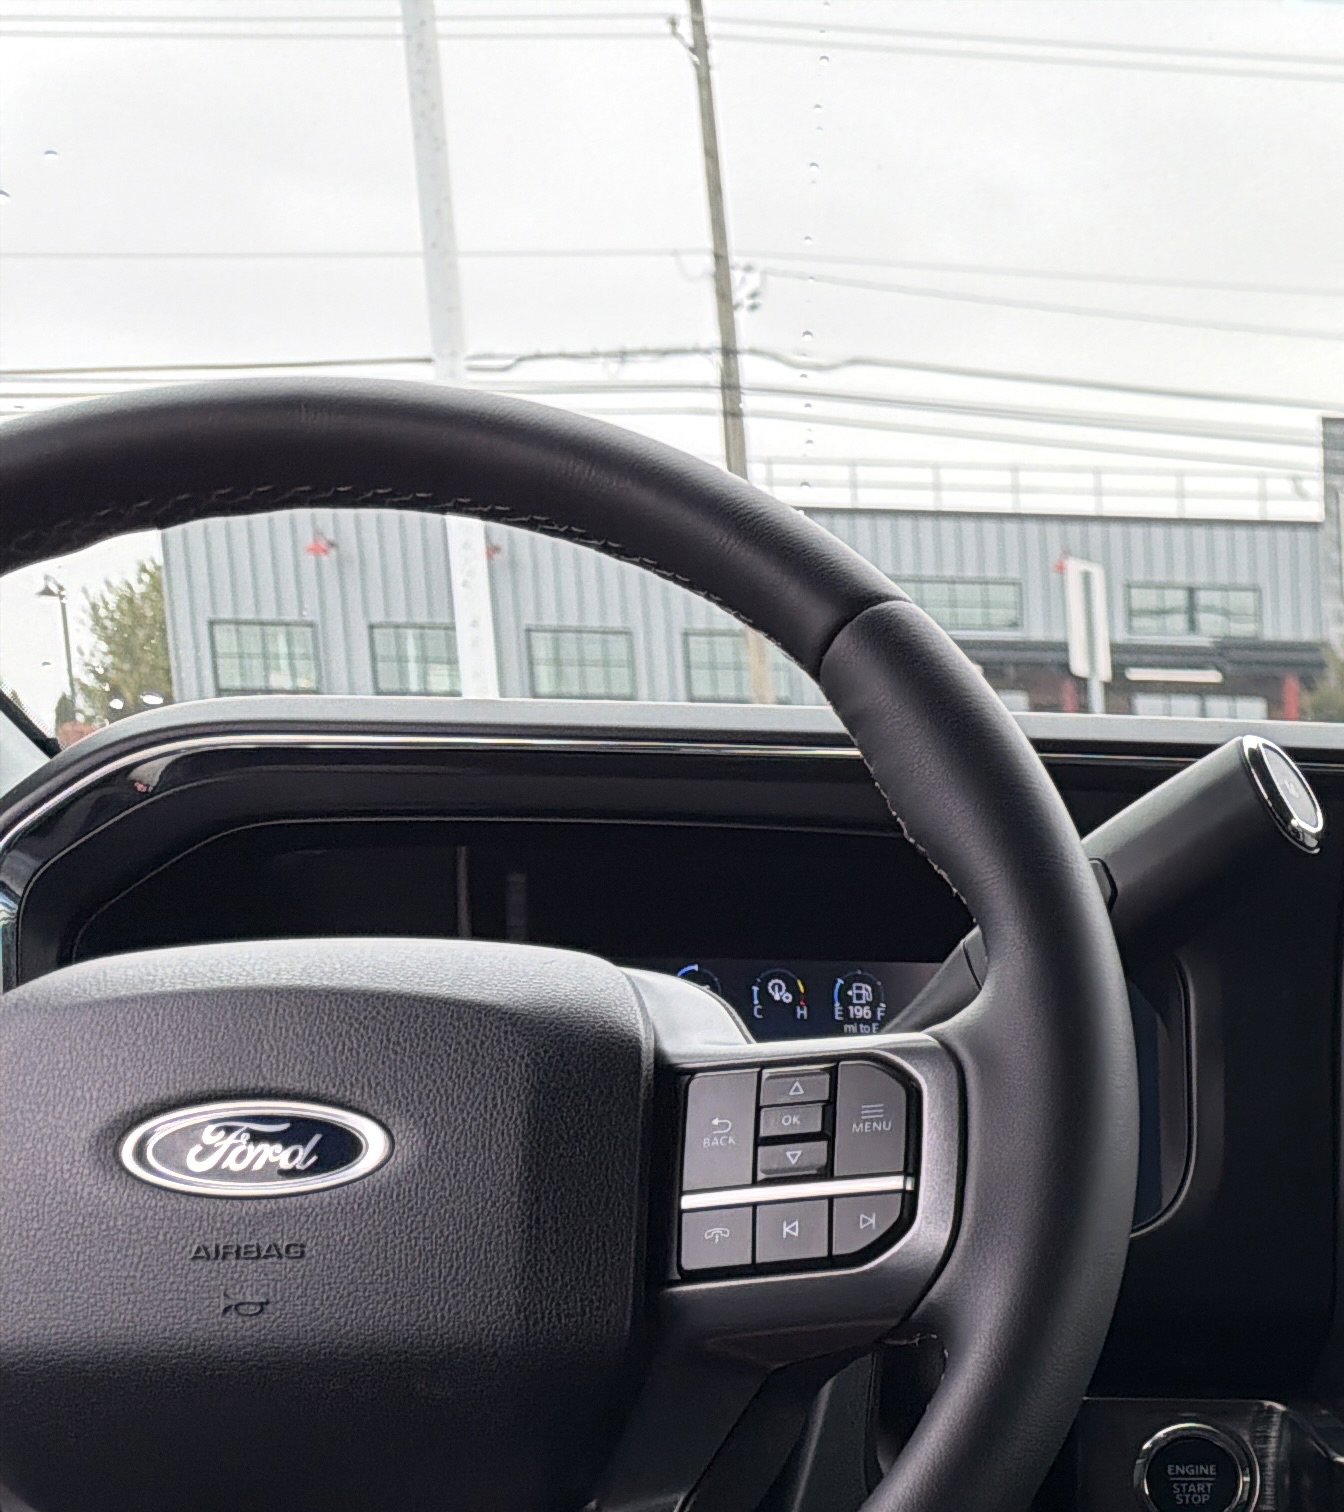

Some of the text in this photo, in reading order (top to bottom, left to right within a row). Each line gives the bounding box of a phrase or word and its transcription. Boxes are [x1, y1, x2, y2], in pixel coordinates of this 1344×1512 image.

[753, 1005, 764, 1019] C
[796, 1005, 808, 1020] H
[834, 1006, 844, 1021] E
[849, 1005, 872, 1019] 196
[877, 1007, 886, 1021] F
[844, 1022, 880, 1034] mi to E
[781, 1114, 801, 1126] OK
[851, 1120, 893, 1134] MENU
[186, 1121, 323, 1173] Ford
[702, 1136, 737, 1150] BACK
[190, 1242, 306, 1260] AIRBAG
[1167, 1464, 1217, 1476] ENGINE
[1172, 1482, 1214, 1494] START
[1175, 1494, 1211, 1505] STOP
